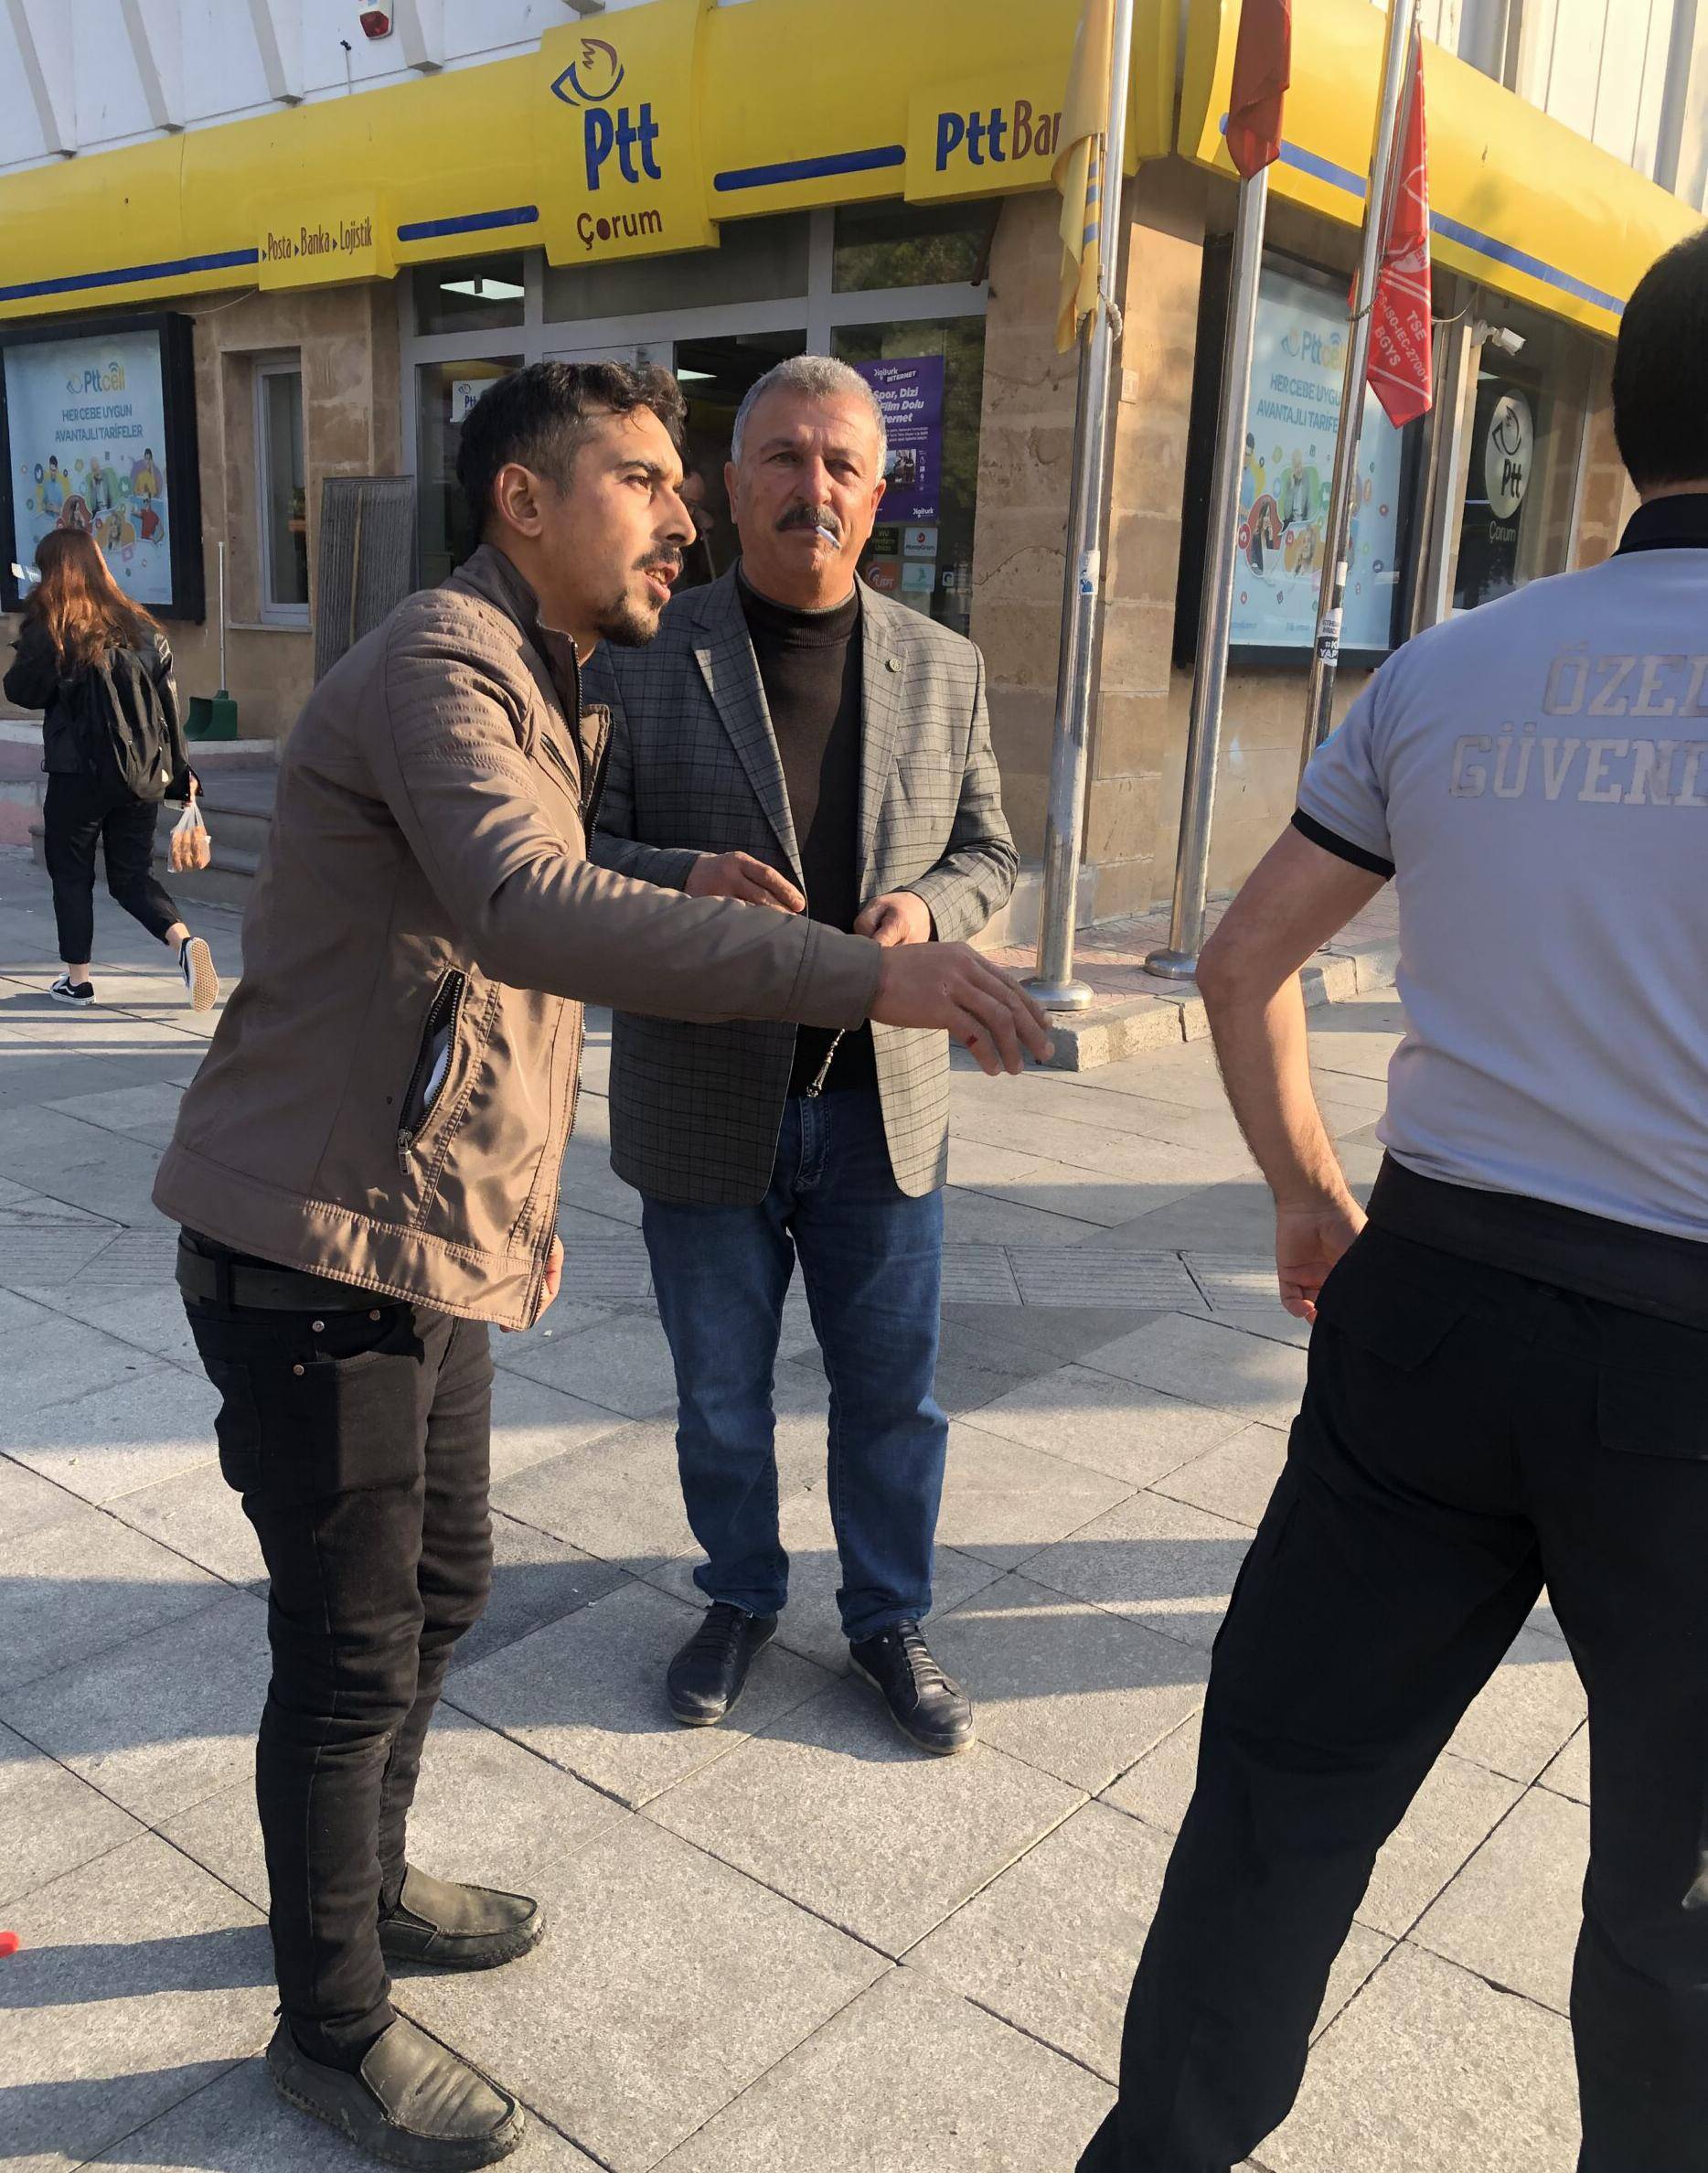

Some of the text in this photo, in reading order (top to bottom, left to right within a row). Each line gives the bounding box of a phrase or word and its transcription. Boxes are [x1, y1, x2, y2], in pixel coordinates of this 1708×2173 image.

[584, 102, 662, 191] Ptt
[267, 216, 372, 261] Posta Banka Lojistik
[576, 209, 663, 251] Çorum
[1406, 310, 1427, 341] TSE
[1374, 325, 1402, 367] BGYS
[84, 366, 126, 393] Pttcell
[886, 370, 917, 382] INTERNET
[1270, 373, 1342, 407] HER CEBE UYGU
[880, 400, 925, 412] Film Dolu
[899, 386, 919, 398] Dizi
[62, 403, 133, 422] HER CEBE UYGUN
[882, 412, 913, 423] ternet
[1256, 398, 1340, 434] AVANTAJLI TARİFE
[55, 423, 144, 443] AVANTAJLI TARİFELER
[1501, 458, 1522, 498] Ptt
[1489, 520, 1517, 544] Çorum
[1319, 648, 1339, 658] YAP
[1541, 641, 1708, 718] ÖZEL
[1449, 721, 1708, 807] GÜVENL
